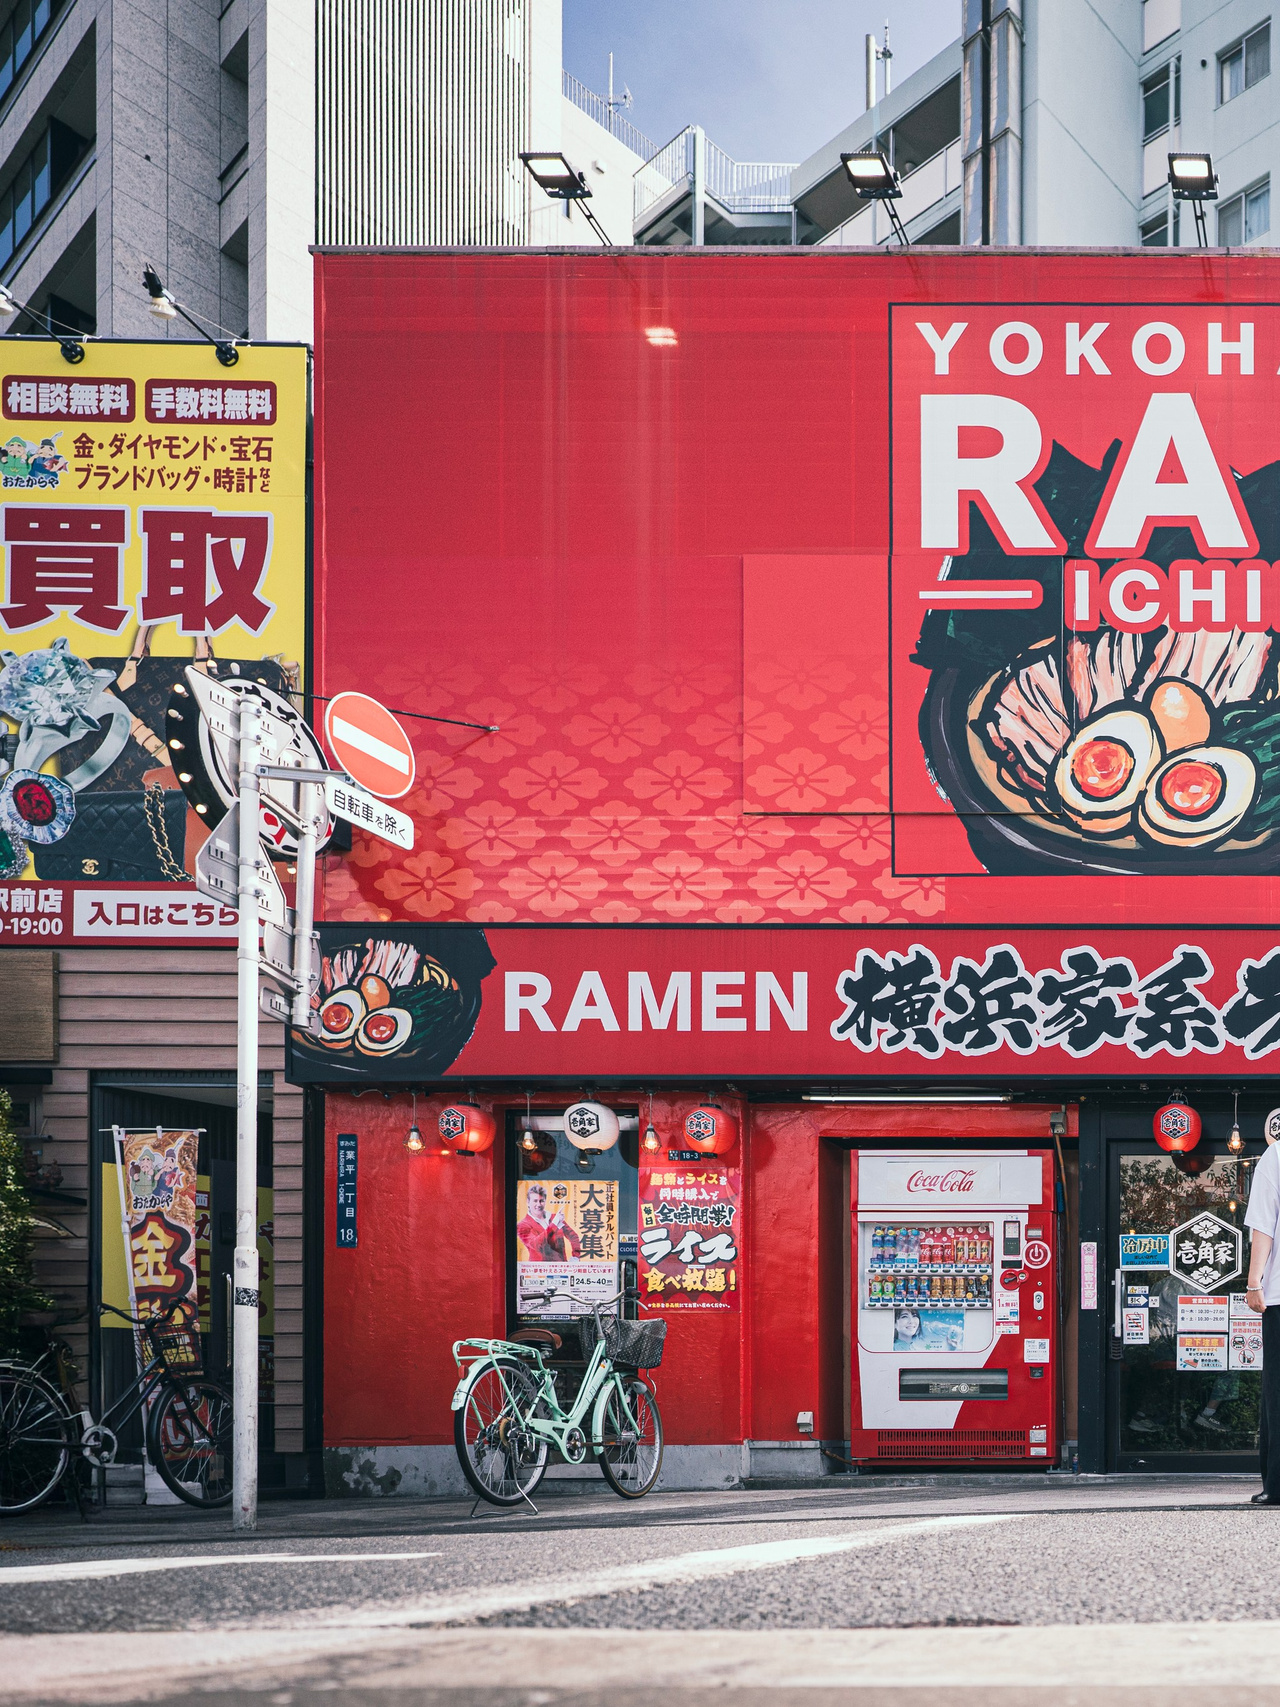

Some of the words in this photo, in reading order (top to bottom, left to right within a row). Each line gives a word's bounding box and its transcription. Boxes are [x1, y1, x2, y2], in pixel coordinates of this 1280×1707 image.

[8, 381, 130, 416] 相談無料
[151, 387, 272, 420] 手数料無料
[73, 433, 273, 462] 金・ダイヤモンド・宝石
[2, 475, 60, 489] おたからや
[0, 505, 274, 635] 買取
[334, 788, 407, 842] 自転車を除く
[87, 901, 264, 926] 入口はこちら
[505, 971, 809, 1032] RAMEN
[571, 1117, 596, 1129] 壱角家
[687, 1119, 711, 1132] 壱角家
[1164, 1118, 1186, 1129] 壱角家
[906, 1169, 978, 1193] Coca-Cola
[133, 1194, 173, 1209] おたからや
[340, 1228, 354, 1240] 18
[579, 1184, 606, 1260] 大募集
[131, 1221, 177, 1288] 金
[640, 1227, 738, 1264] ライス
[1123, 1237, 1167, 1253] 冷房中
[1177, 1240, 1236, 1265] 壱角家
